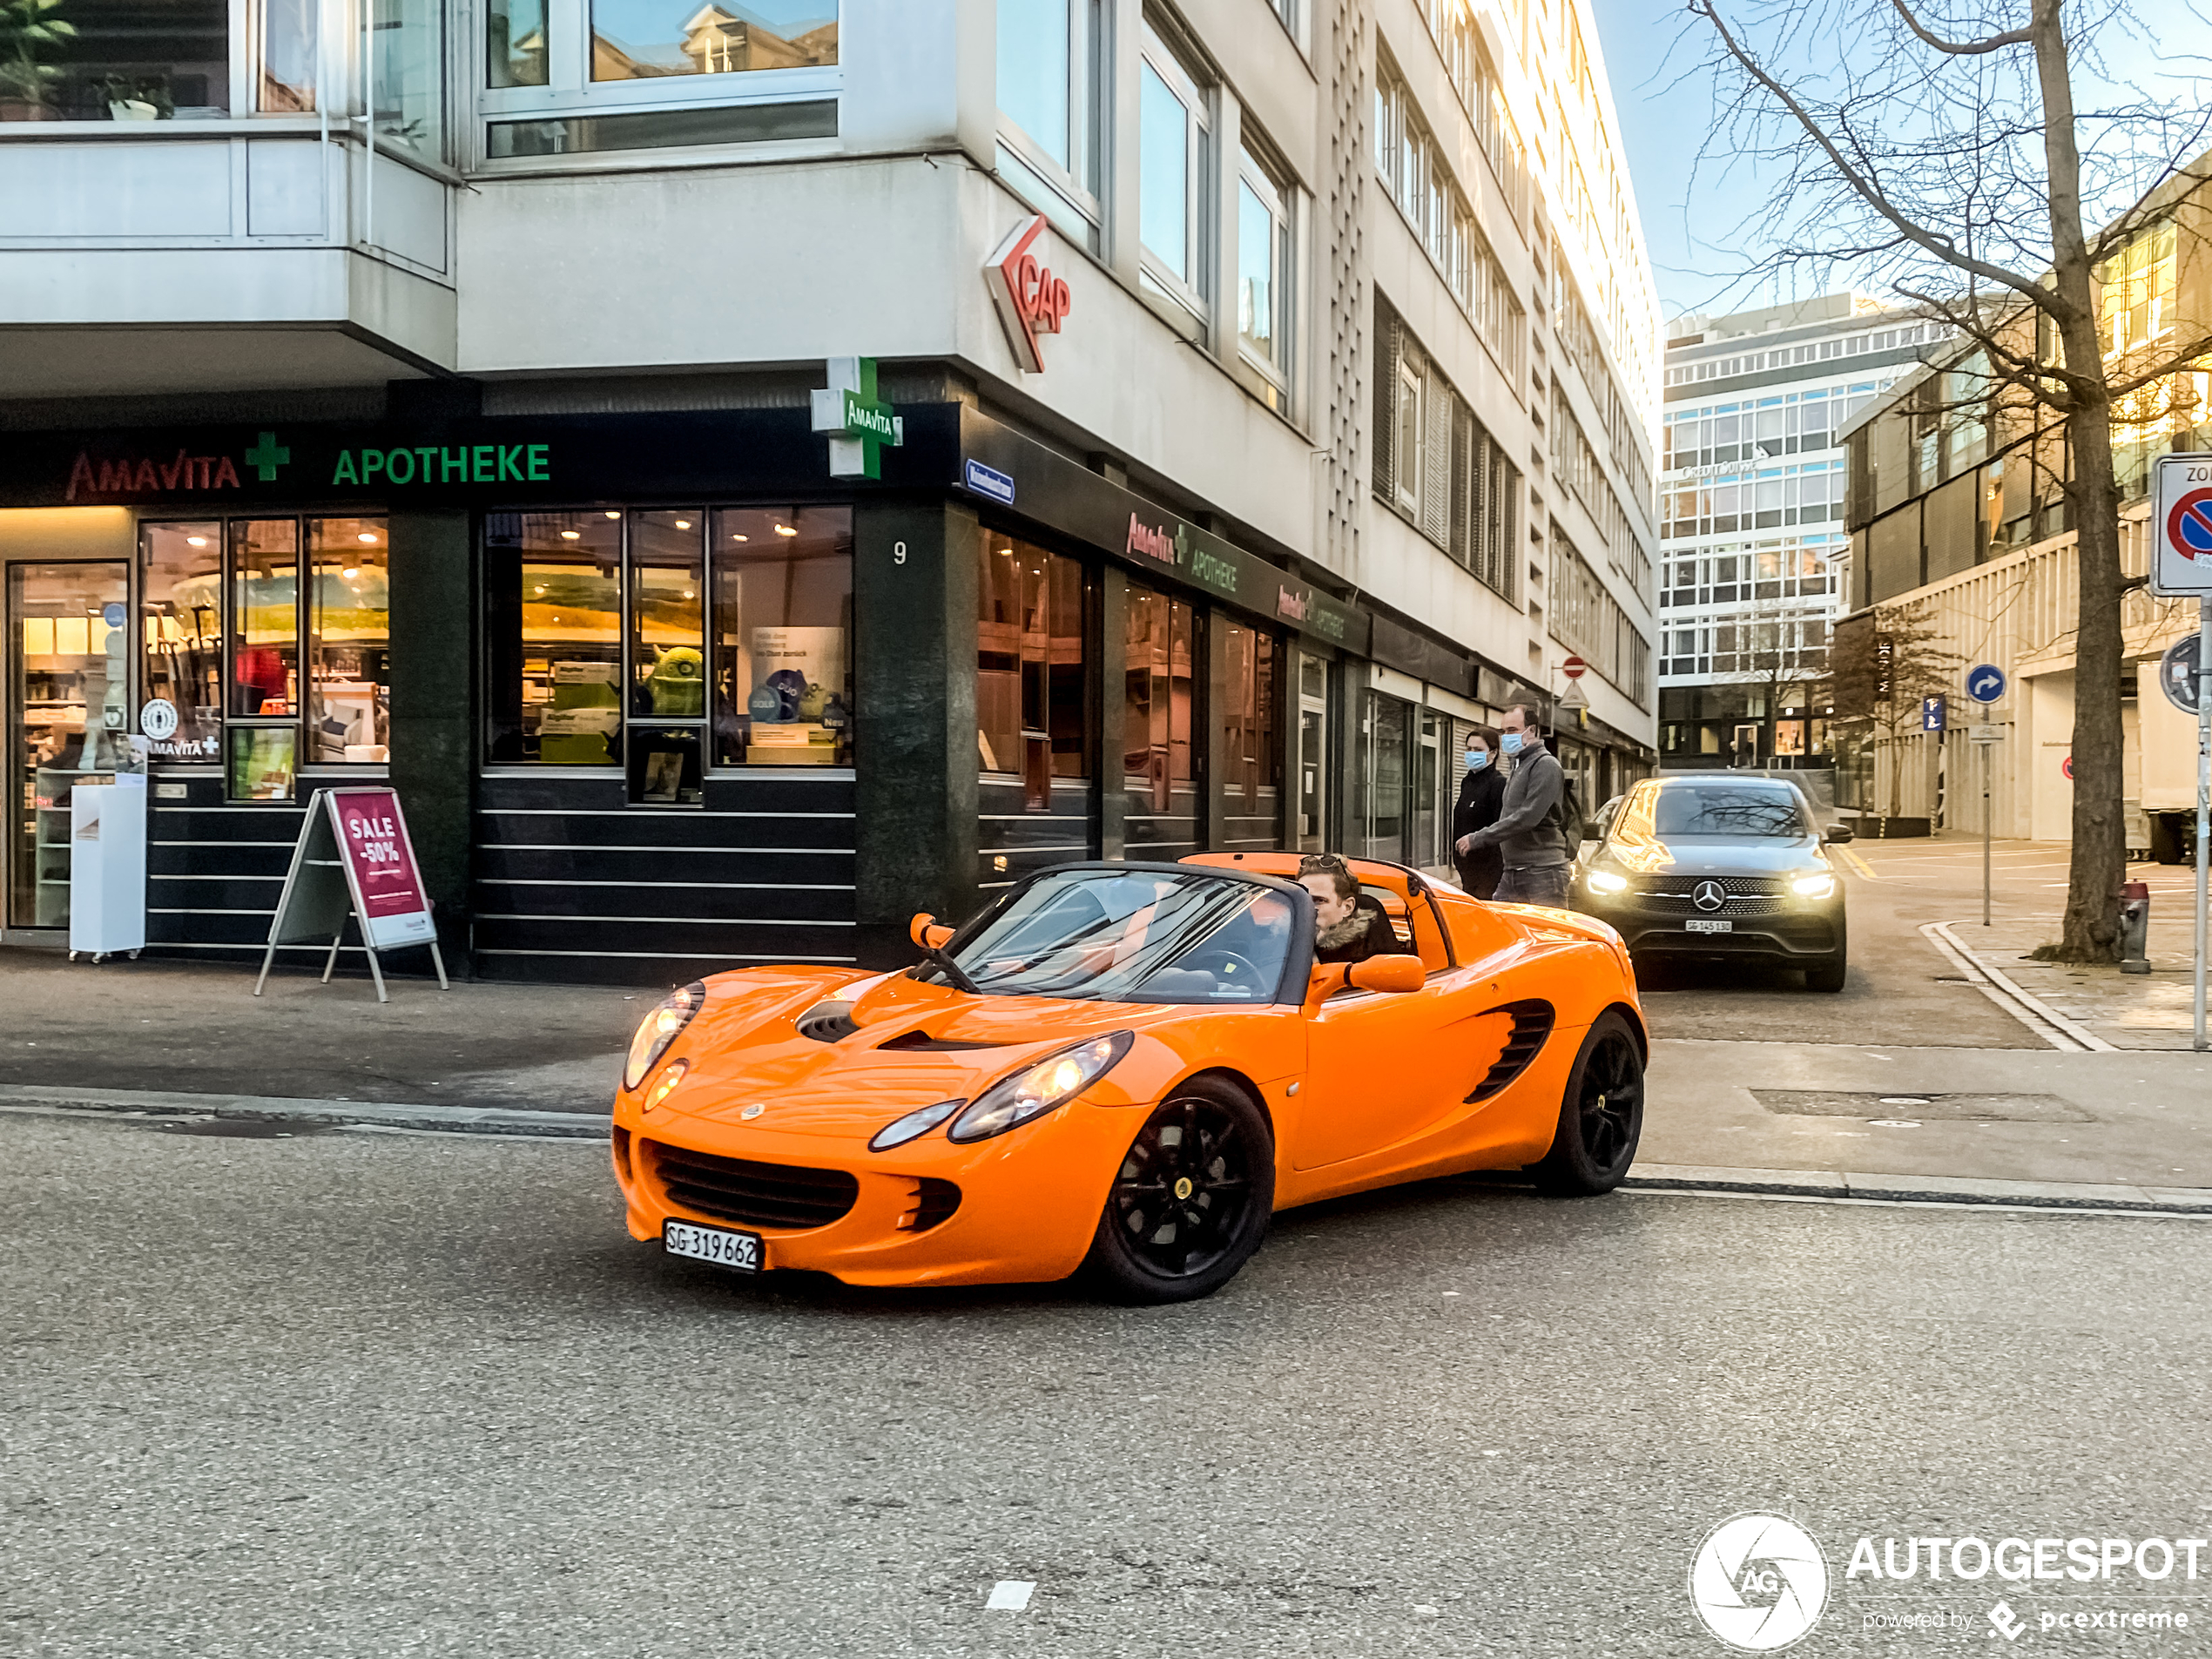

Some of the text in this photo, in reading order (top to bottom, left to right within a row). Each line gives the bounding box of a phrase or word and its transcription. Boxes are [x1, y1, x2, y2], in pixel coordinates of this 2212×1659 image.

[1018, 254, 1070, 334] CAP
[847, 400, 892, 435] AMAVITA
[66, 444, 550, 500] AMAVITA APOTHEKE
[2187, 467, 2212, 482] ZO
[894, 541, 907, 564] 9
[1191, 549, 1237, 592] APOTHEKE
[778, 682, 798, 697] DUO
[824, 718, 844, 726] Neu
[349, 817, 395, 839] SALE
[360, 841, 400, 863] -50%
